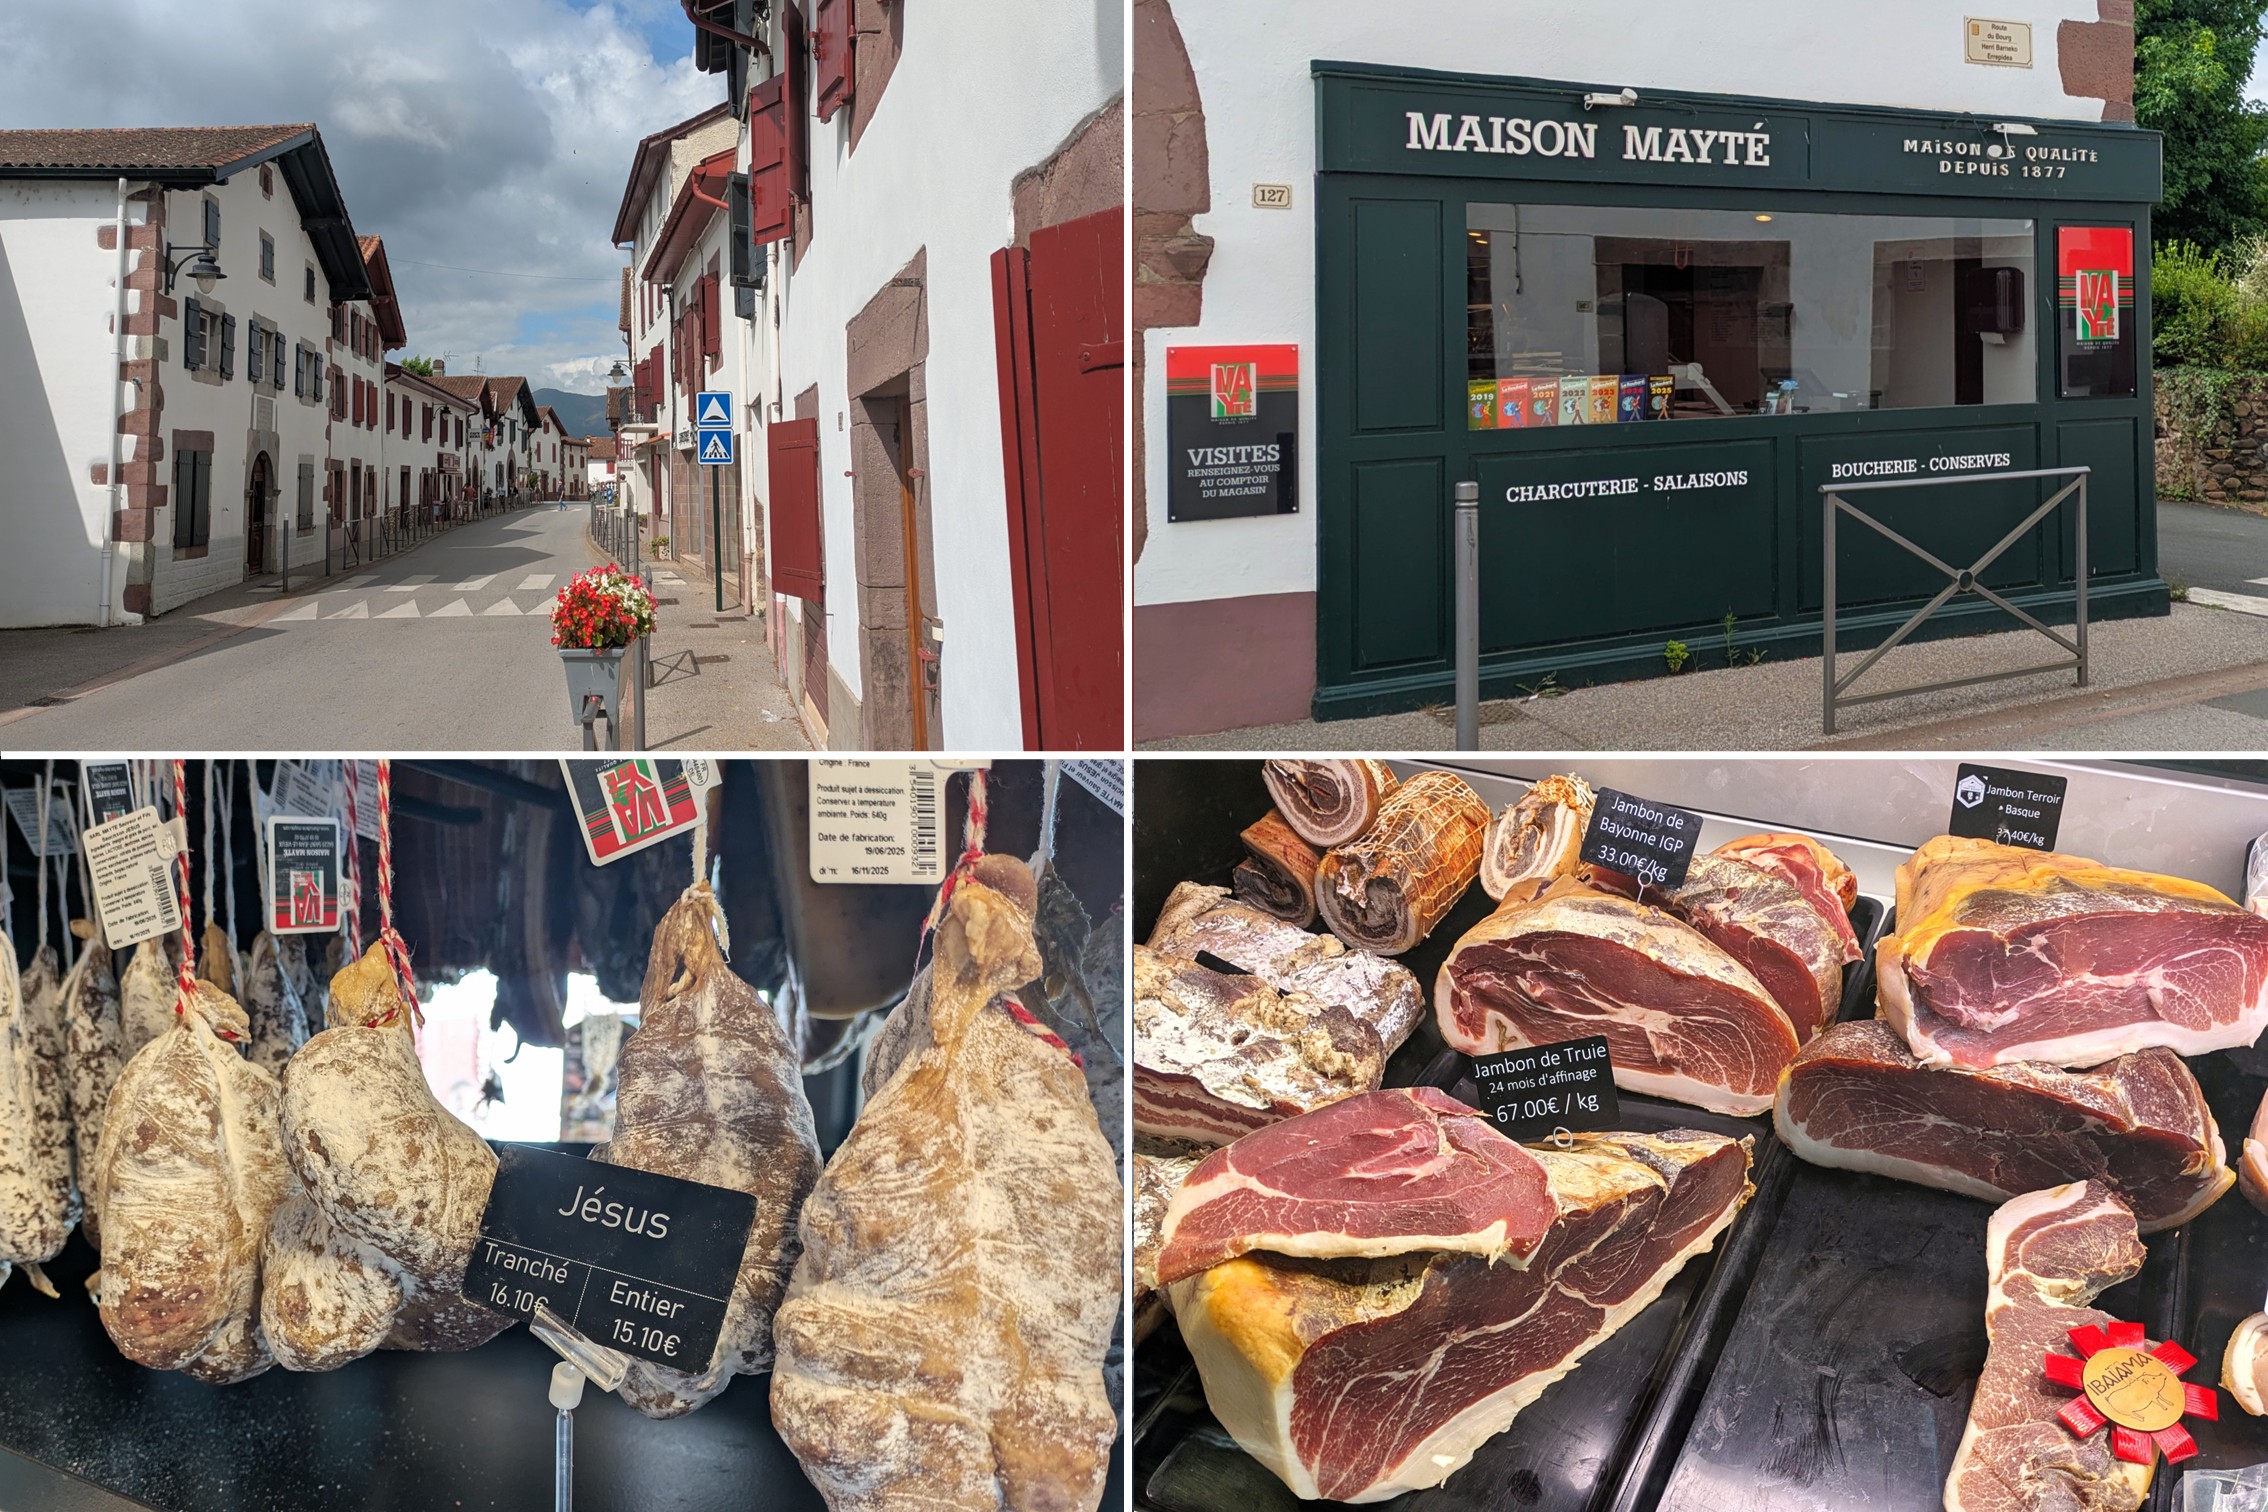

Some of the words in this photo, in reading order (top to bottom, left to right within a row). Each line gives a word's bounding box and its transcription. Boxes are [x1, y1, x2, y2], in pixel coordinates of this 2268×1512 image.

[1996, 34, 2012, 42] Bourg
[1987, 53, 2012, 62] Errepidea
[1406, 111, 1598, 158] MAISON
[1622, 122, 1770, 167] MAYTÉ
[2021, 166, 2066, 178] 1877
[1260, 189, 1285, 202] 127
[1187, 444, 1280, 466] VISITES
[1187, 464, 1280, 477] RENSEIGNEZ-VOUS
[1832, 459, 1917, 478] BOUCHERIE
[1929, 453, 2010, 471] CONSERVES
[1217, 475, 1269, 486] COMPTOIR
[1506, 478, 1639, 502] CHARCUTERIE
[1653, 471, 1748, 492] SALAISONS
[1202, 490, 1216, 498] DU
[1219, 486, 1266, 496] MAGASIN
[688, 767, 695, 776] CE
[700, 762, 706, 772] FR
[1078, 760, 1100, 778] JESUS
[816, 784, 840, 792] Produit
[841, 785, 857, 794] sujet
[1076, 772, 1101, 793] Sauveur
[817, 797, 850, 805] Conserver
[1987, 784, 2024, 799] Jambon
[2027, 791, 2061, 804] Terroir
[872, 811, 887, 821] 640g
[1611, 796, 1663, 824] Jambon
[1666, 813, 1684, 830] de
[2005, 804, 2041, 819] Basque
[102, 831, 125, 841] Saucisson
[125, 824, 140, 833] JESUS
[818, 832, 836, 842] Date
[839, 833, 849, 842] de
[852, 833, 895, 842] fabrication:
[1600, 817, 1656, 846] Bayonne
[1659, 835, 1684, 853] IGP
[865, 847, 905, 855] 19/06/2025
[851, 866, 889, 875] 16/11/2025
[1598, 845, 1668, 882] 33.00€/kg
[103, 899, 120, 908] Conserver
[1474, 1056, 1536, 1079] Jambon
[1541, 1051, 1560, 1067] de
[1564, 1044, 1607, 1063] Truie
[1488, 1081, 1505, 1094] 24
[1507, 1078, 1536, 1091] mois
[1538, 1068, 1597, 1086] d'affinage
[1496, 1097, 1560, 1123] 67.00€
[1564, 1093, 1571, 1114] /
[1577, 1092, 1600, 1112] kg
[558, 1185, 671, 1239] Jésus
[484, 1241, 570, 1284] Tranché
[489, 1282, 549, 1312] 16.10€
[609, 1280, 684, 1319] Entier
[612, 1318, 681, 1358] 15.10€
